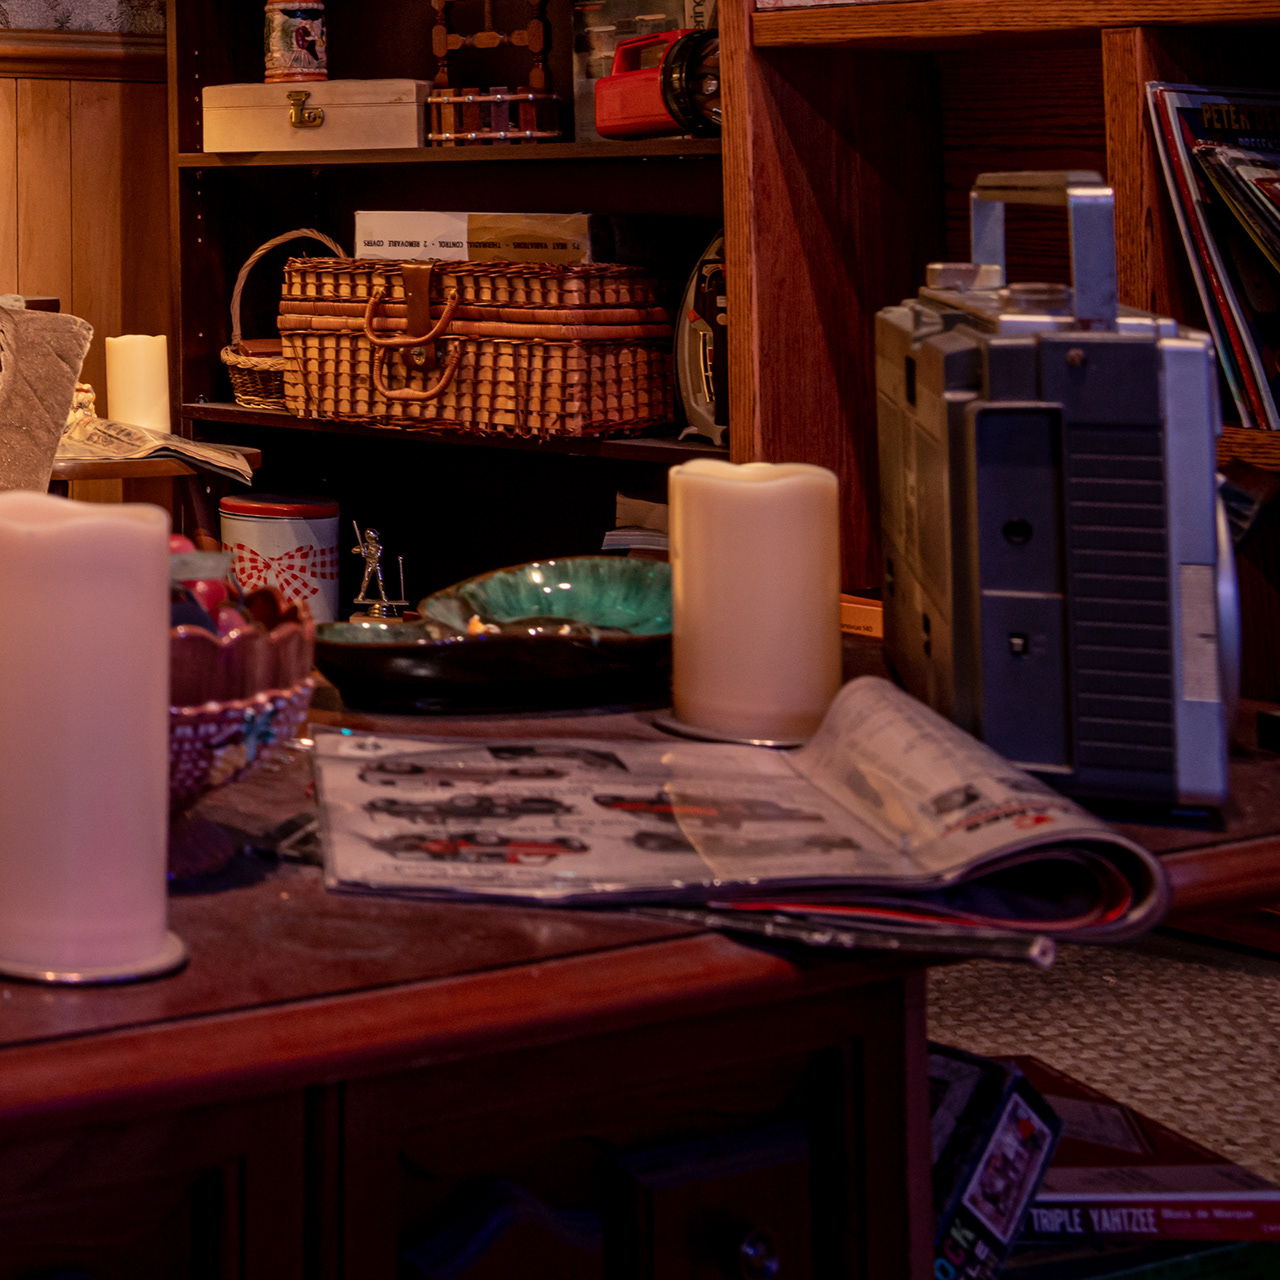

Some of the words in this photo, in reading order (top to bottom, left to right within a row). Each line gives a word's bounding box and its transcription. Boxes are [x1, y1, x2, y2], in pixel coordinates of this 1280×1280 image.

[1201, 103, 1251, 131] PETER
[363, 239, 384, 247] COVERS
[388, 240, 420, 248] REMOVABLE
[438, 240, 463, 249] CONTROL
[512, 241, 549, 250] VARIATIONS
[552, 242, 568, 250] HEAT
[1030, 1208, 1084, 1233] TRIPLE
[1088, 1208, 1159, 1234] YAHTZEE
